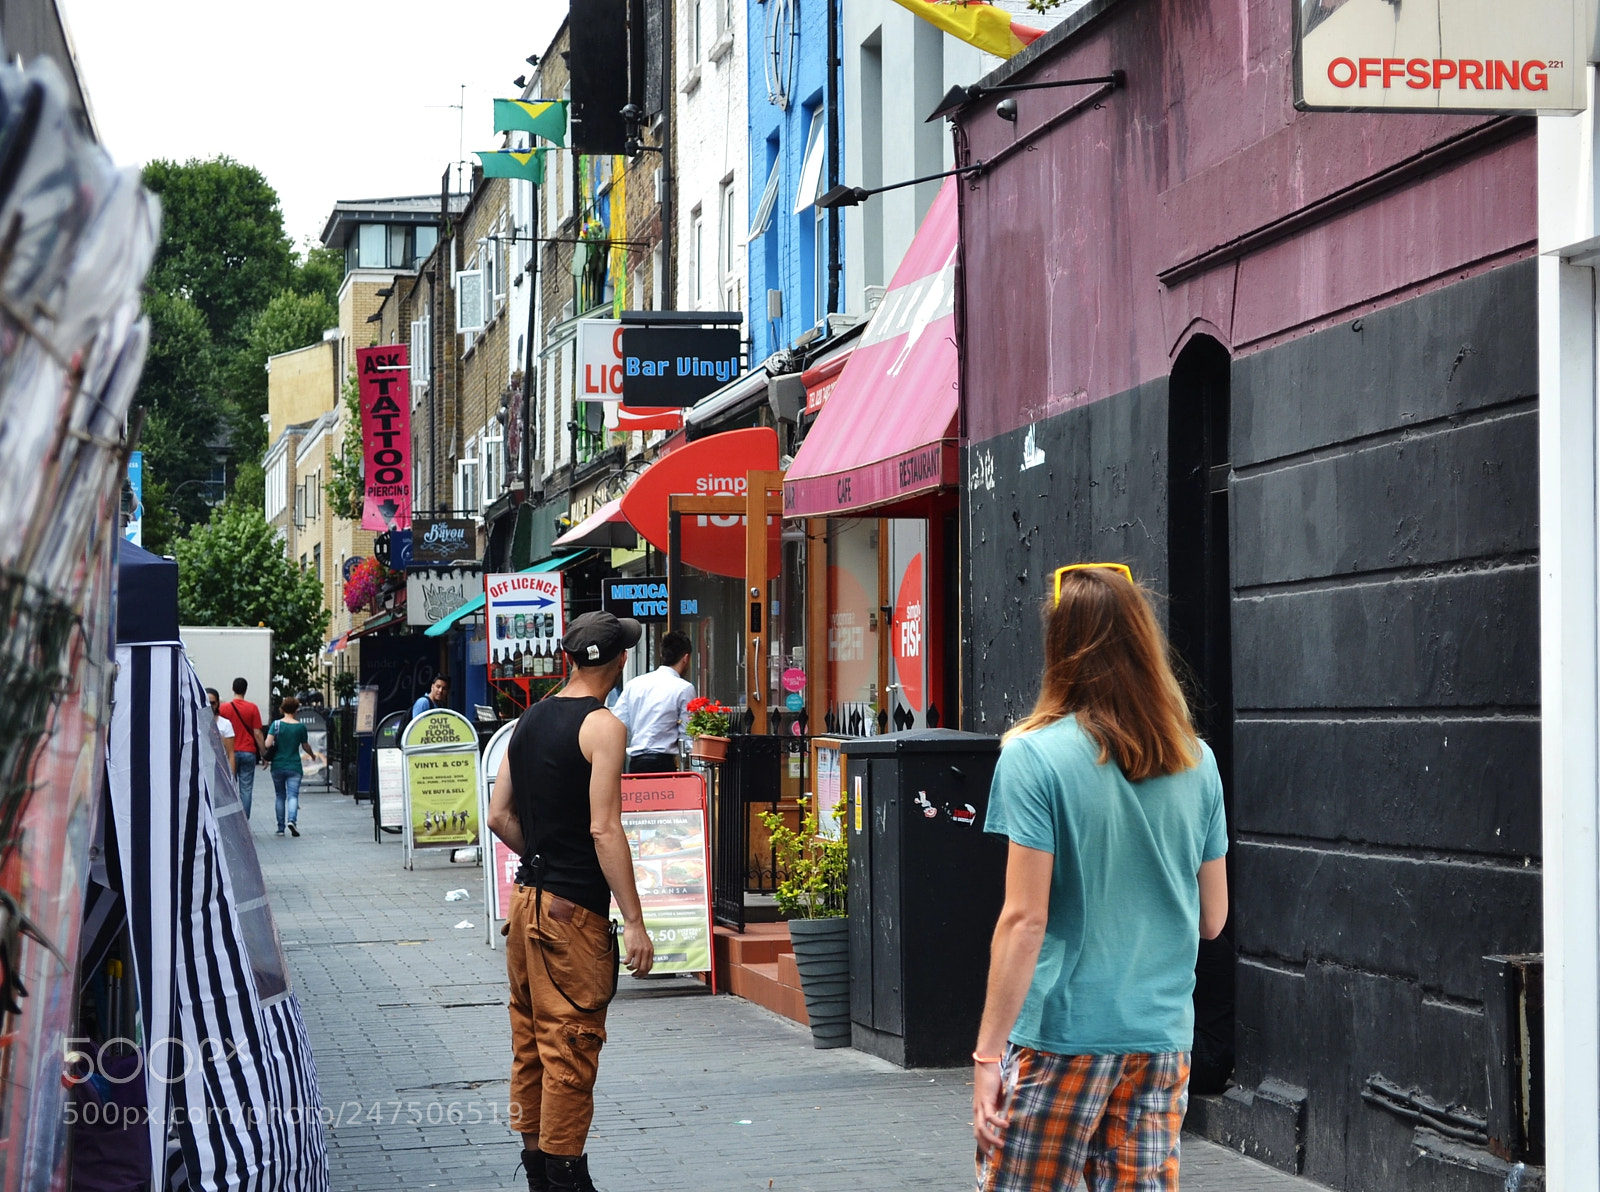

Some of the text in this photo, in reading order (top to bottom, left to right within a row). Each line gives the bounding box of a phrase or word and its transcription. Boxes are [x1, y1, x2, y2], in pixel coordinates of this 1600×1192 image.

[1327, 56, 1564, 92] OFFSPRING 221
[363, 353, 402, 375] ASK
[626, 356, 738, 382] Bar Vinyl
[369, 377, 403, 485] TATTOO
[899, 447, 941, 488] RESTAURANT
[696, 473, 748, 493] simp
[837, 477, 852, 504] CAFE
[423, 523, 465, 542] Bayou
[489, 577, 559, 598] OFF LICENCE
[611, 583, 668, 600] MEXICA
[632, 599, 698, 616] KITCEN
[425, 729, 455, 737] FLOOR
[621, 790, 675, 803] argansa
